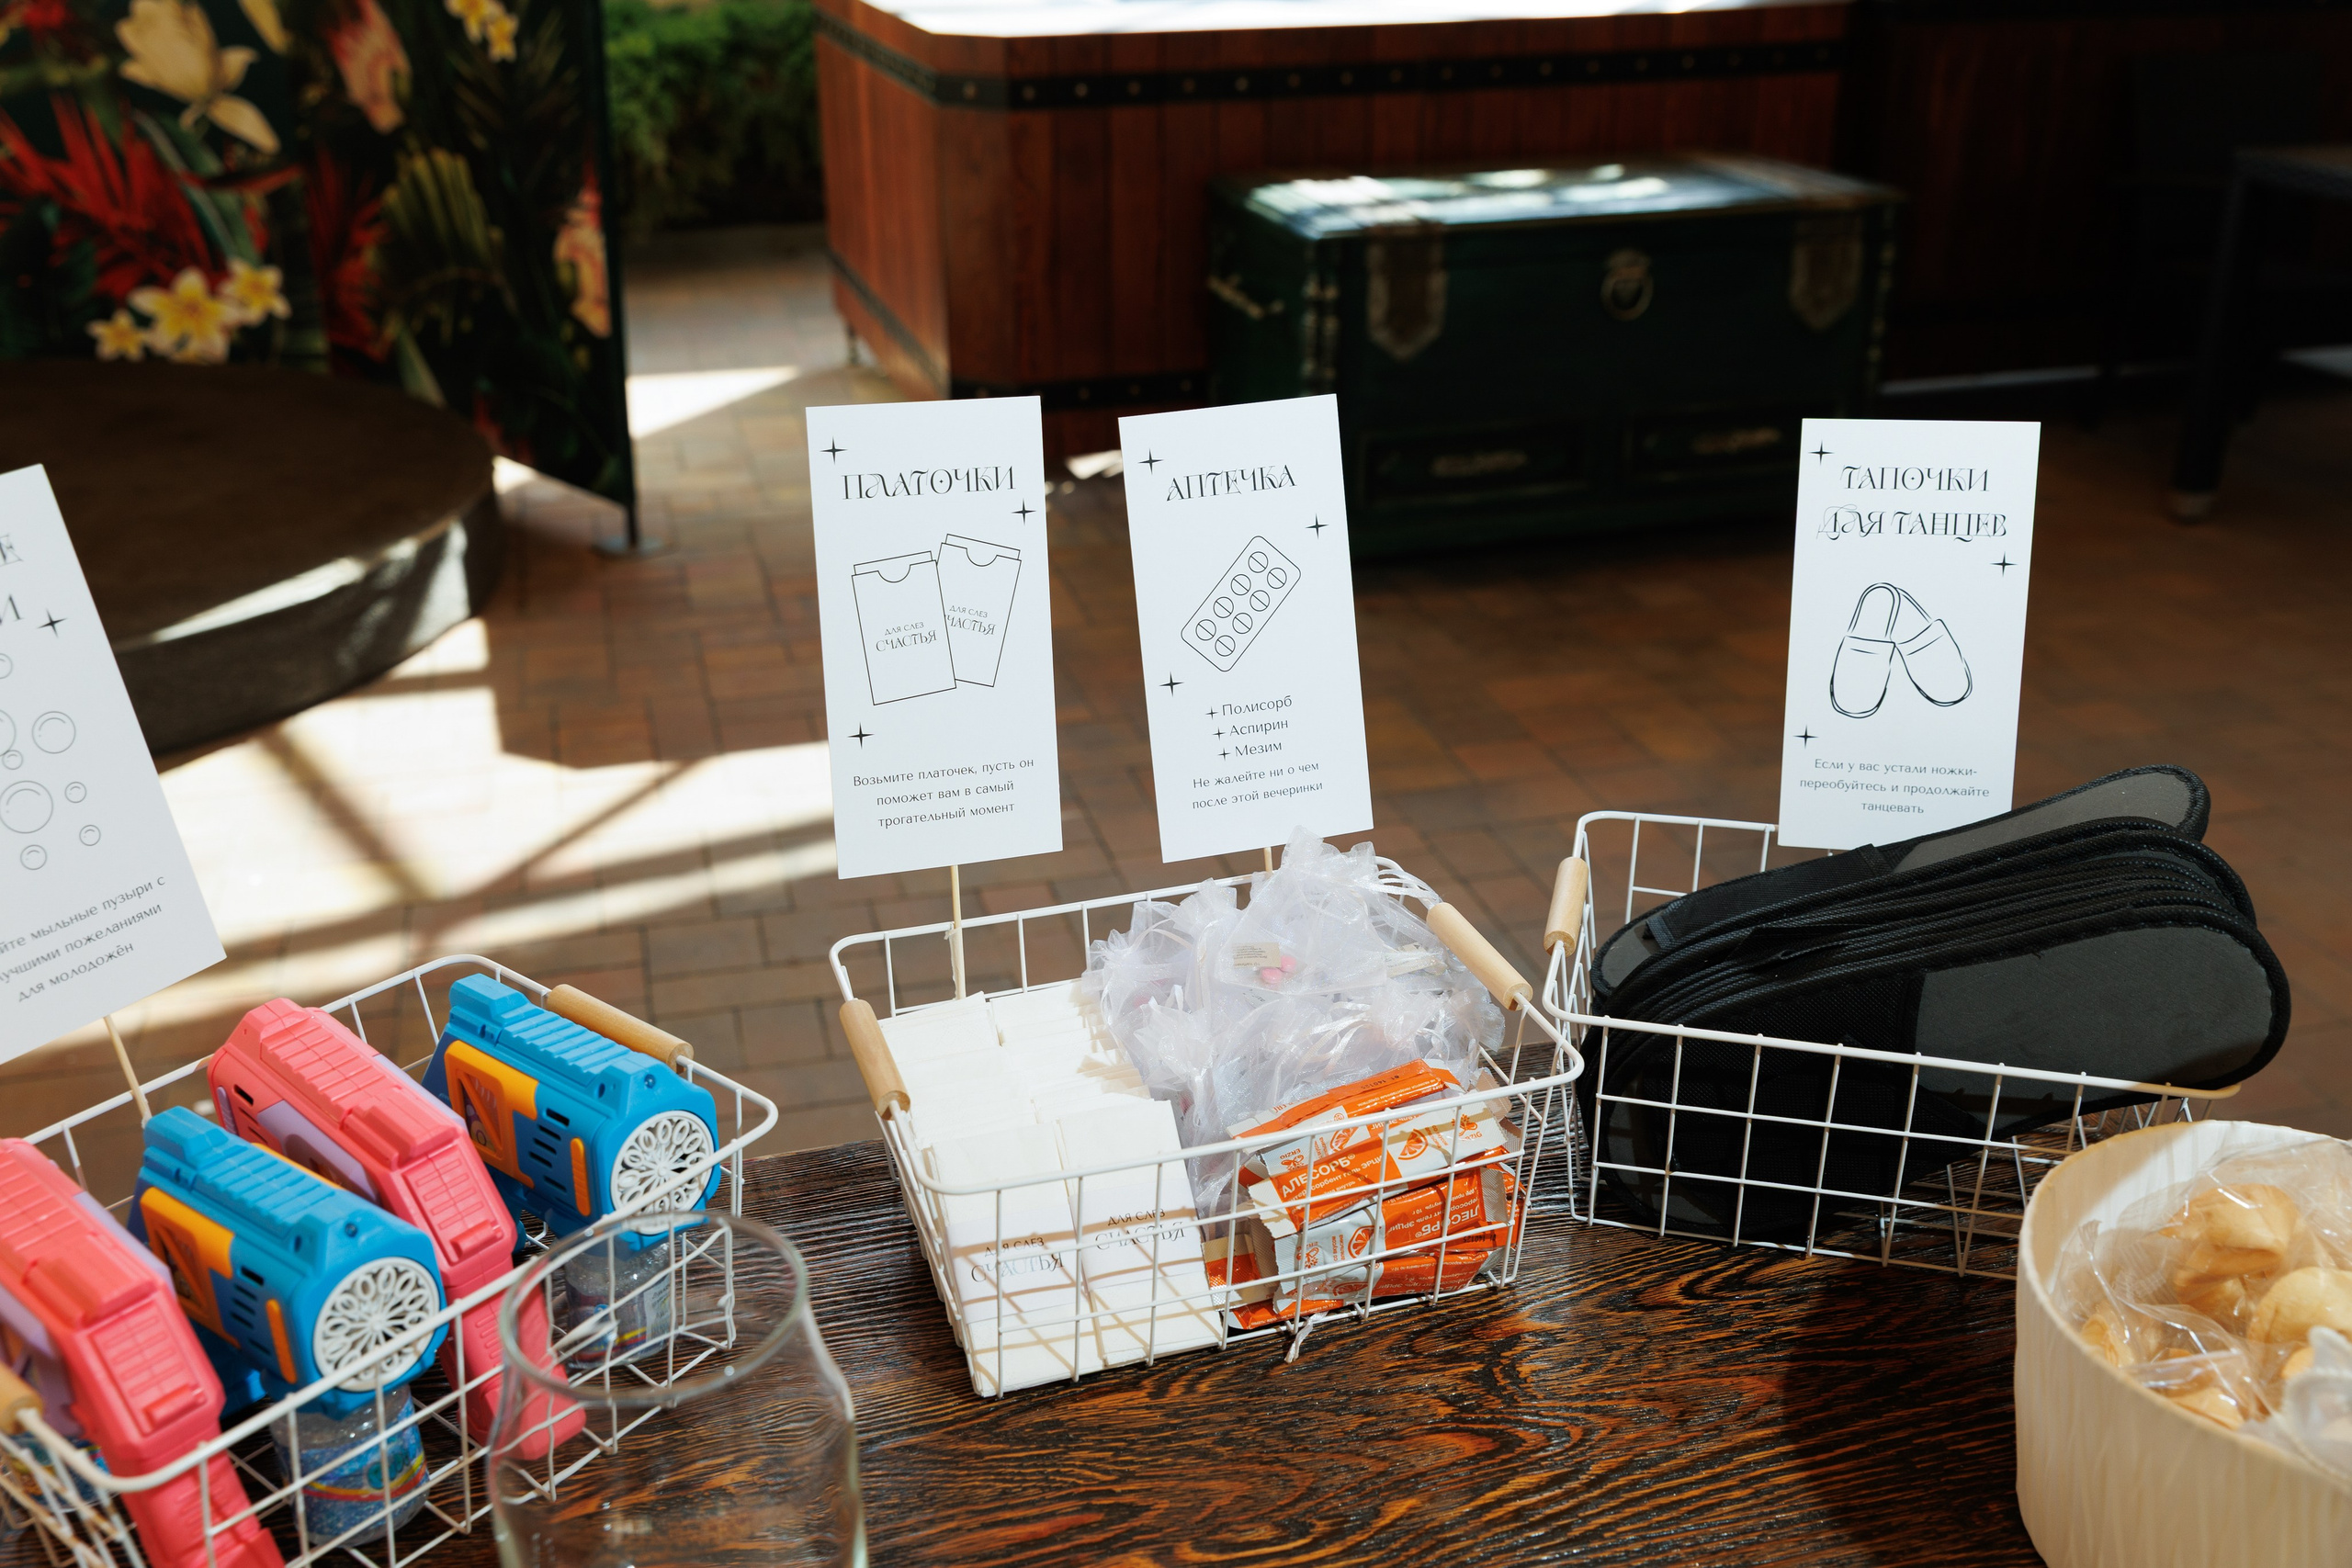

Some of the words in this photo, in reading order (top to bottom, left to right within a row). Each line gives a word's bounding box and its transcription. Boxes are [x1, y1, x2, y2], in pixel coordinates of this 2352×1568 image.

[842, 466, 1016, 500] ПЛАТОЧКИ
[1167, 464, 1297, 502] АПТЕЧКА
[1839, 465, 1990, 492] ТАПОЧКИ
[1815, 503, 1886, 541] ДЛЯ
[1891, 510, 2007, 542] ТАНЦЕВ
[949, 605, 967, 615] ДЛЯ
[968, 608, 989, 618] СЛЕЗ
[885, 626, 901, 636] ДЛЯ
[904, 622, 924, 632] СЛЕЗ
[945, 615, 996, 636] ЧАСТЬЯ
[876, 629, 937, 652] СЧАСТЬЯ
[1222, 694, 1293, 716] Полисорб
[1229, 720, 1288, 736] Аспирин
[1235, 742, 1283, 757] Мезим
[854, 773, 914, 786] Возьмите
[919, 765, 978, 780] платочек,
[982, 761, 1015, 775] пусть
[1019, 759, 1035, 769] он
[1193, 778, 1210, 788] Не
[1214, 771, 1265, 785] жалейте
[1270, 768, 1283, 777] ни
[1287, 766, 1295, 774] о
[1298, 762, 1319, 773] чем
[1815, 759, 1844, 770] Если
[1848, 761, 1855, 773] у
[1859, 762, 1880, 772] вас
[1883, 763, 1927, 774] устали
[1931, 766, 1977, 776] ножки-
[876, 792, 933, 806] поможет
[938, 789, 960, 799] вам
[965, 787, 971, 796] в
[976, 781, 1014, 795] самый
[1193, 796, 1227, 809] после
[1231, 790, 1260, 804] этой
[1263, 782, 1323, 799] вечеринки
[1800, 779, 1886, 793] переобуйтесь
[1891, 784, 1899, 792] и
[1904, 784, 1990, 797] продолжайте
[878, 807, 966, 829] трогательный
[969, 803, 1015, 816] момент
[1861, 802, 1925, 814] танцевать
[30, 906, 98, 941] мыльные
[102, 882, 153, 910] пузыри
[157, 876, 166, 886] с
[64, 904, 163, 953] пожеланиями
[18, 982, 46, 1002] для
[49, 942, 134, 987] молодожён
[1361, 1155, 1383, 1169] ЭРЦИ
[1107, 1213, 1132, 1226] ДЛЯ
[984, 1242, 1010, 1258] ДЯ
[1013, 1236, 1045, 1252] СЛЕЗ
